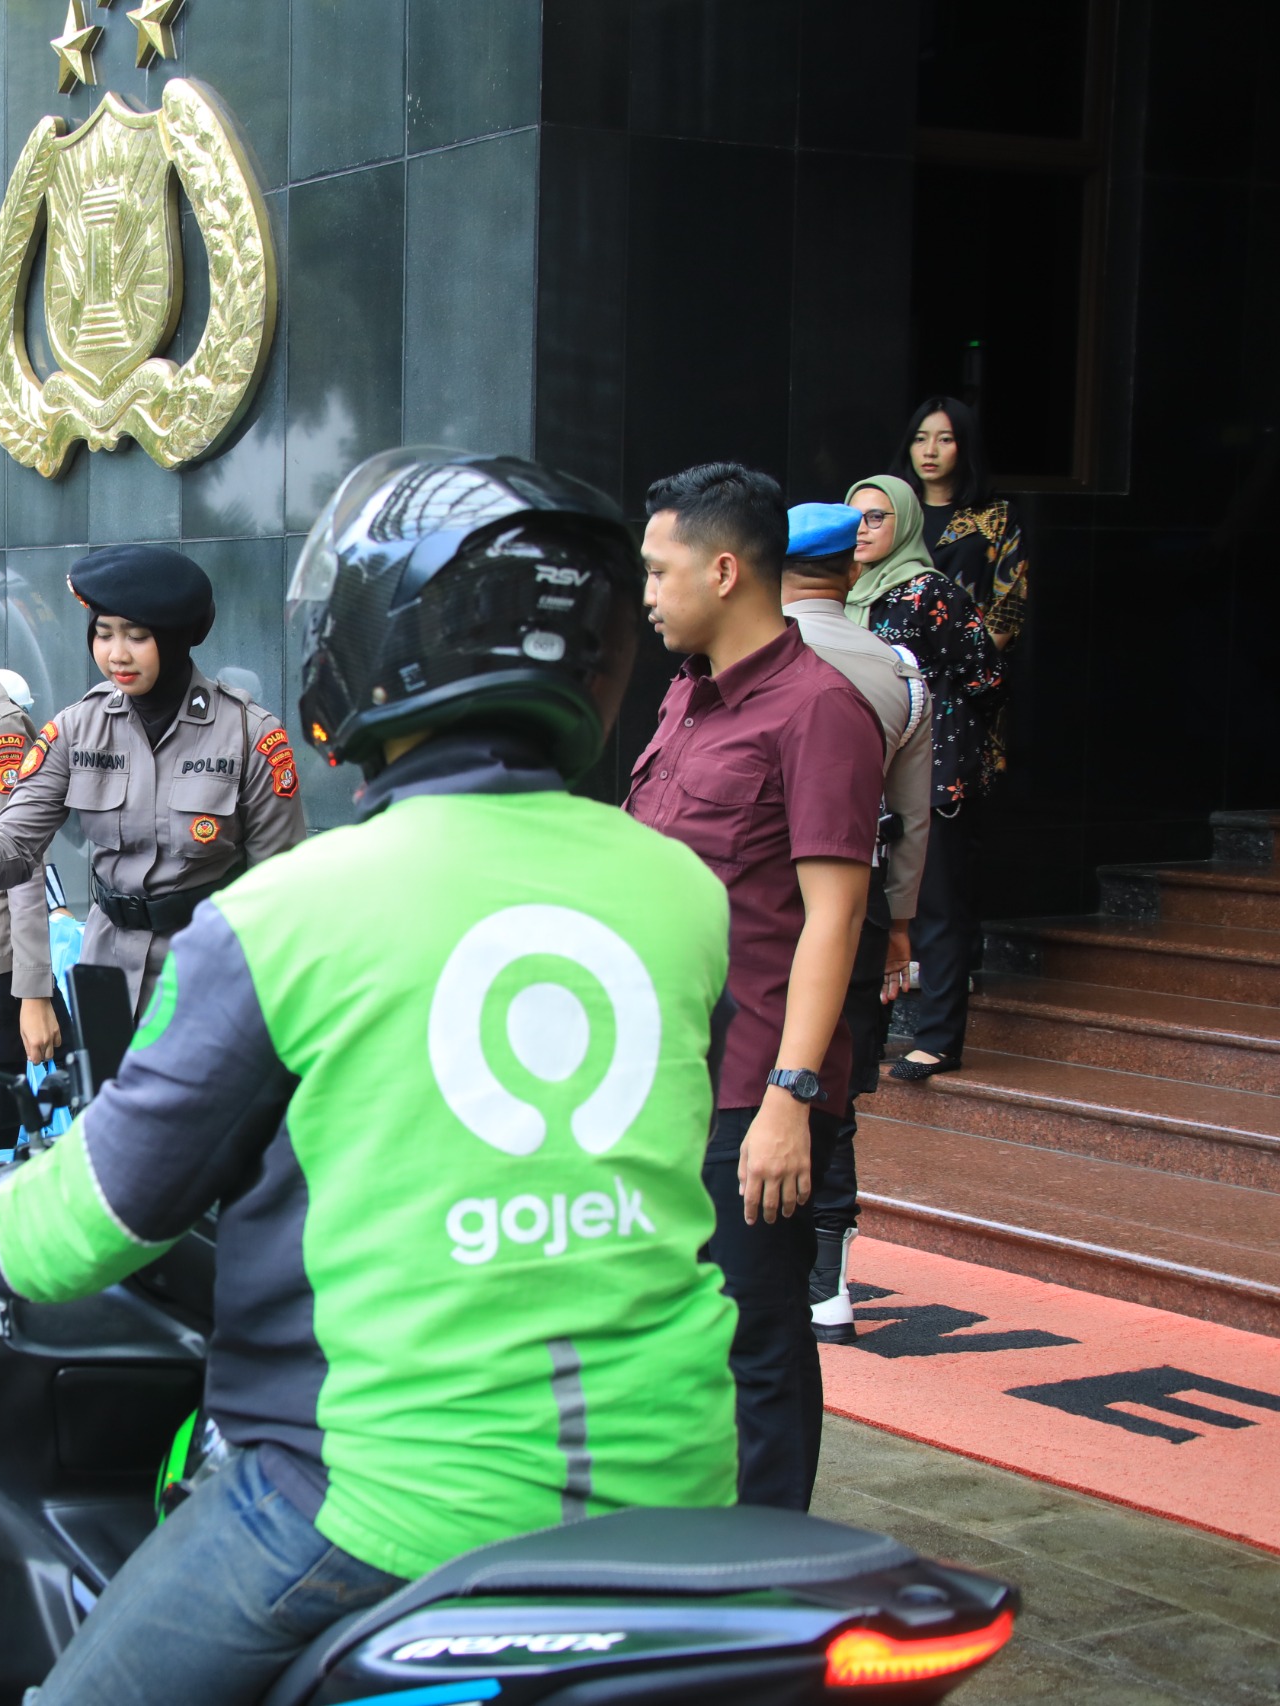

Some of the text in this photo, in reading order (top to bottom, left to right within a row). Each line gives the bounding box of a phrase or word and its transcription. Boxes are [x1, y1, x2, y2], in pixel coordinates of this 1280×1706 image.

[534, 564, 591, 586] RSV
[261, 732, 286, 752] POLDA
[73, 751, 235, 774] PINKAN POLRI
[446, 1175, 656, 1265] gojek
